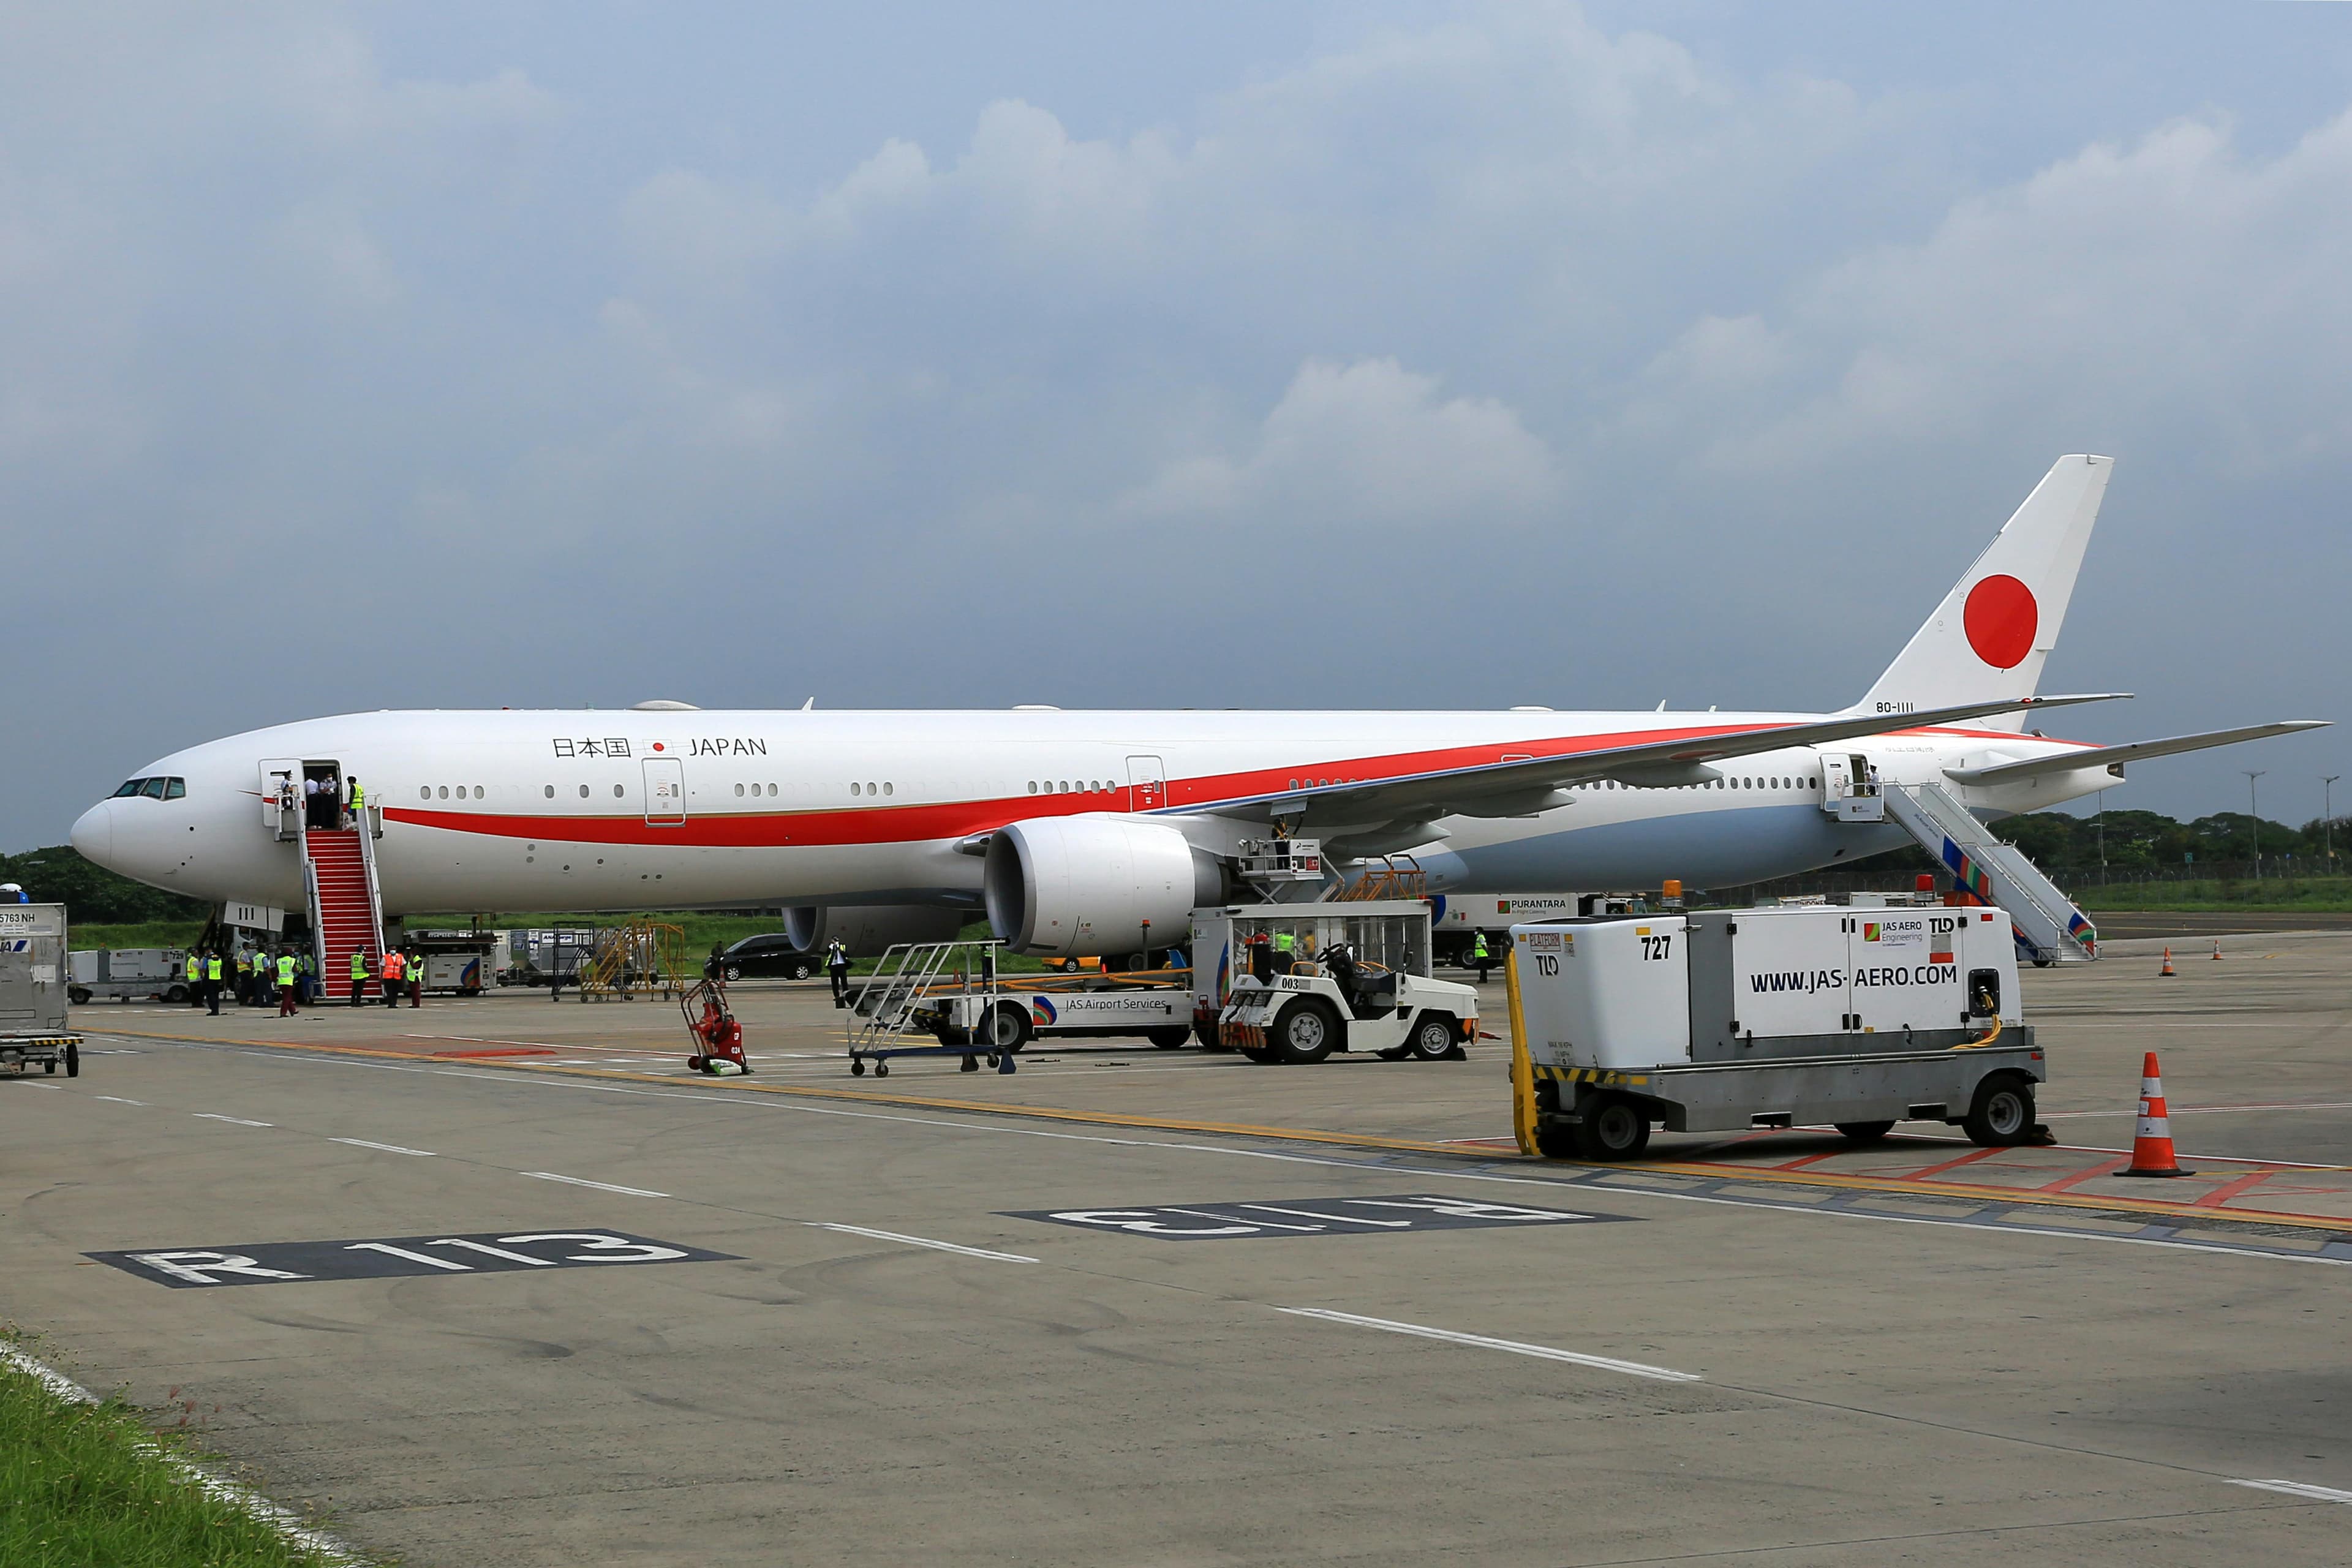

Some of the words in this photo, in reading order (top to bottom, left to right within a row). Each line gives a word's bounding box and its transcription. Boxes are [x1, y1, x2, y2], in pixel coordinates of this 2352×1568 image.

[1876, 702, 1913, 713] 80-1111
[552, 737, 631, 758] 日本国
[690, 738, 767, 756] JAPAN
[21, 913, 35, 922] NH
[1882, 922, 1897, 931] JAS
[1898, 921, 1922, 930] AERO
[1929, 918, 1954, 933] TLD
[1529, 934, 1559, 946] PLATFORM
[1882, 933, 1923, 942] Engineering
[1641, 935, 1671, 960] 727
[1536, 955, 1559, 976] TLD
[1281, 978, 1298, 990] 003
[1066, 1000, 1083, 1012] JAS
[1085, 999, 1121, 1011] Airport
[1124, 998, 1166, 1009] Services
[125, 1251, 315, 1284] R
[343, 1234, 690, 1271] 113
